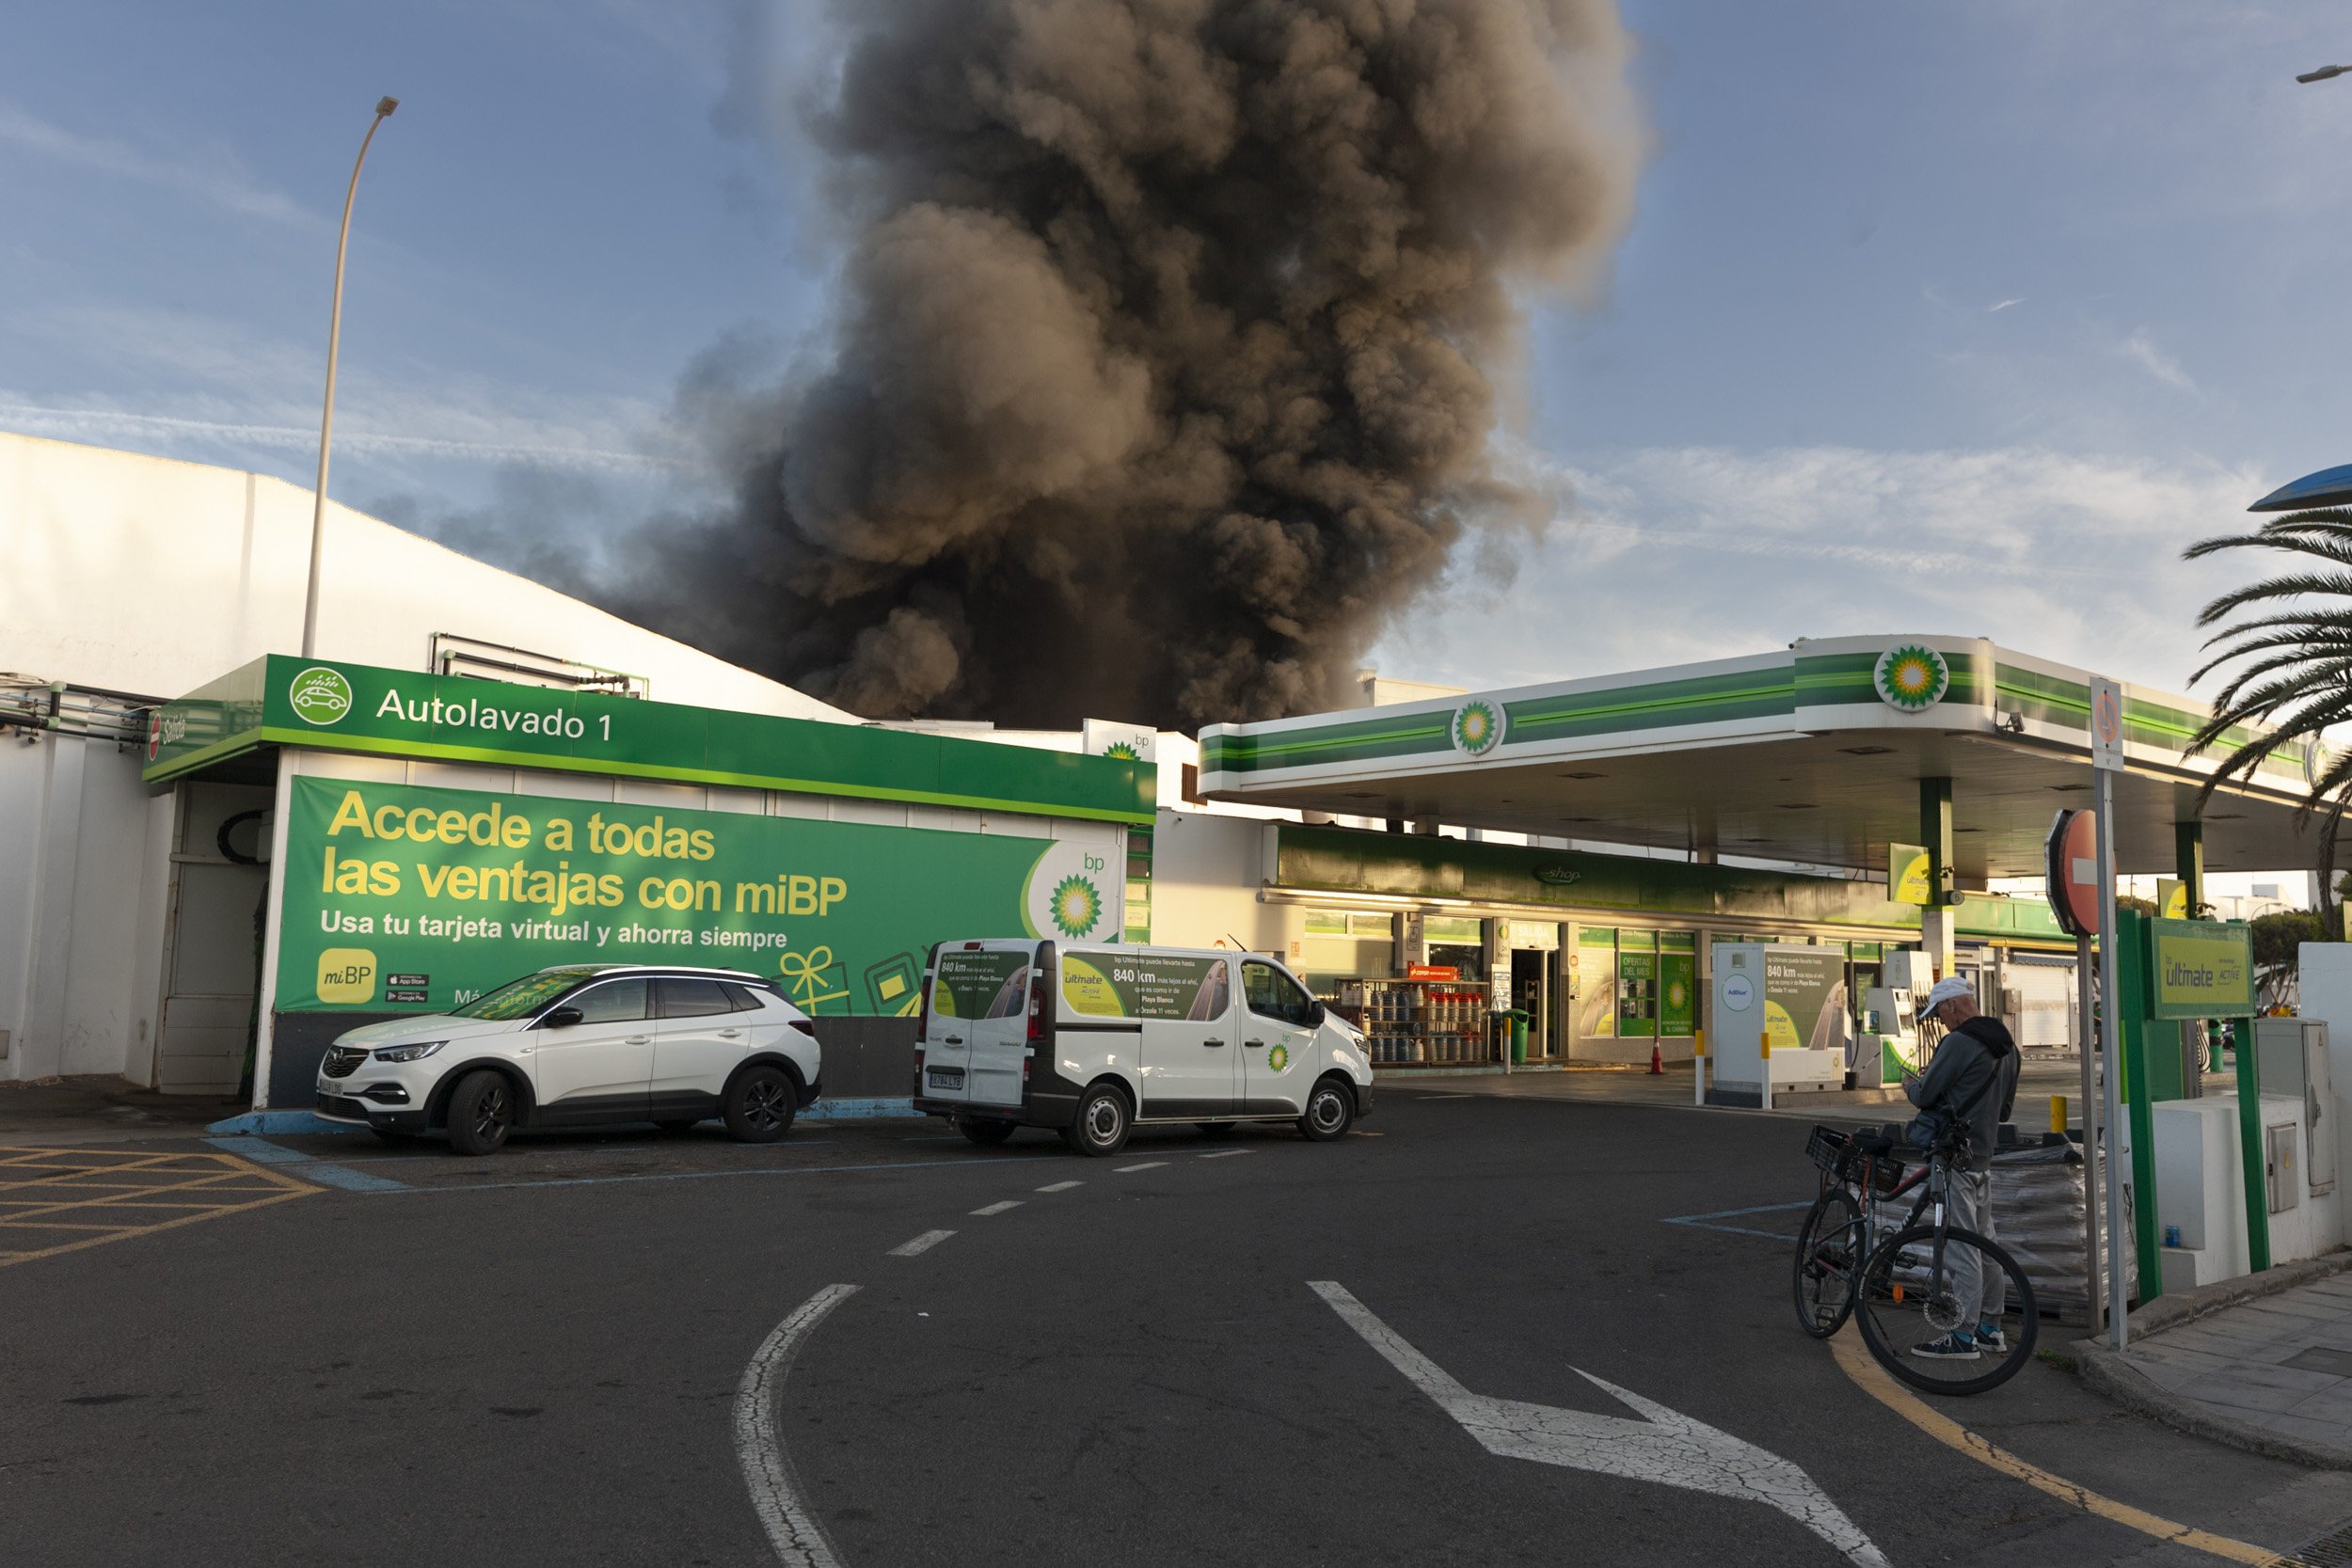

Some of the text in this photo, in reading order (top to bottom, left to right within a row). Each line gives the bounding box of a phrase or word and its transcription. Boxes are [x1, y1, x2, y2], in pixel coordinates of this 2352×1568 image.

[376, 689, 611, 741] Autolavado 1
[163, 713, 186, 745] Salida
[1135, 734, 1150, 748] bp
[326, 790, 716, 861] Accede a todas
[1084, 852, 1104, 874] bp
[323, 846, 848, 917] las ventajas con miBP
[1549, 865, 1581, 882] shop
[321, 910, 787, 952] Usa tu tarjeta virtual y ahorra siempre
[941, 961, 954, 973] 840
[954, 961, 966, 973] km
[1623, 958, 1651, 966] OFERTAS
[1679, 961, 1690, 974] bp
[324, 965, 372, 985] miBP
[1113, 969, 1135, 983] 840
[1137, 969, 1156, 984] km
[1624, 967, 1650, 975] DEL MES
[1767, 965, 1782, 977] 840
[1783, 965, 1796, 977] km
[2166, 962, 2241, 987] ultimate ACTIVE
[1065, 974, 1103, 985] ultimate
[454, 988, 485, 1005] Má
[1141, 995, 1174, 1004] Playa Blanca
[1281, 1032, 1292, 1043] bp
